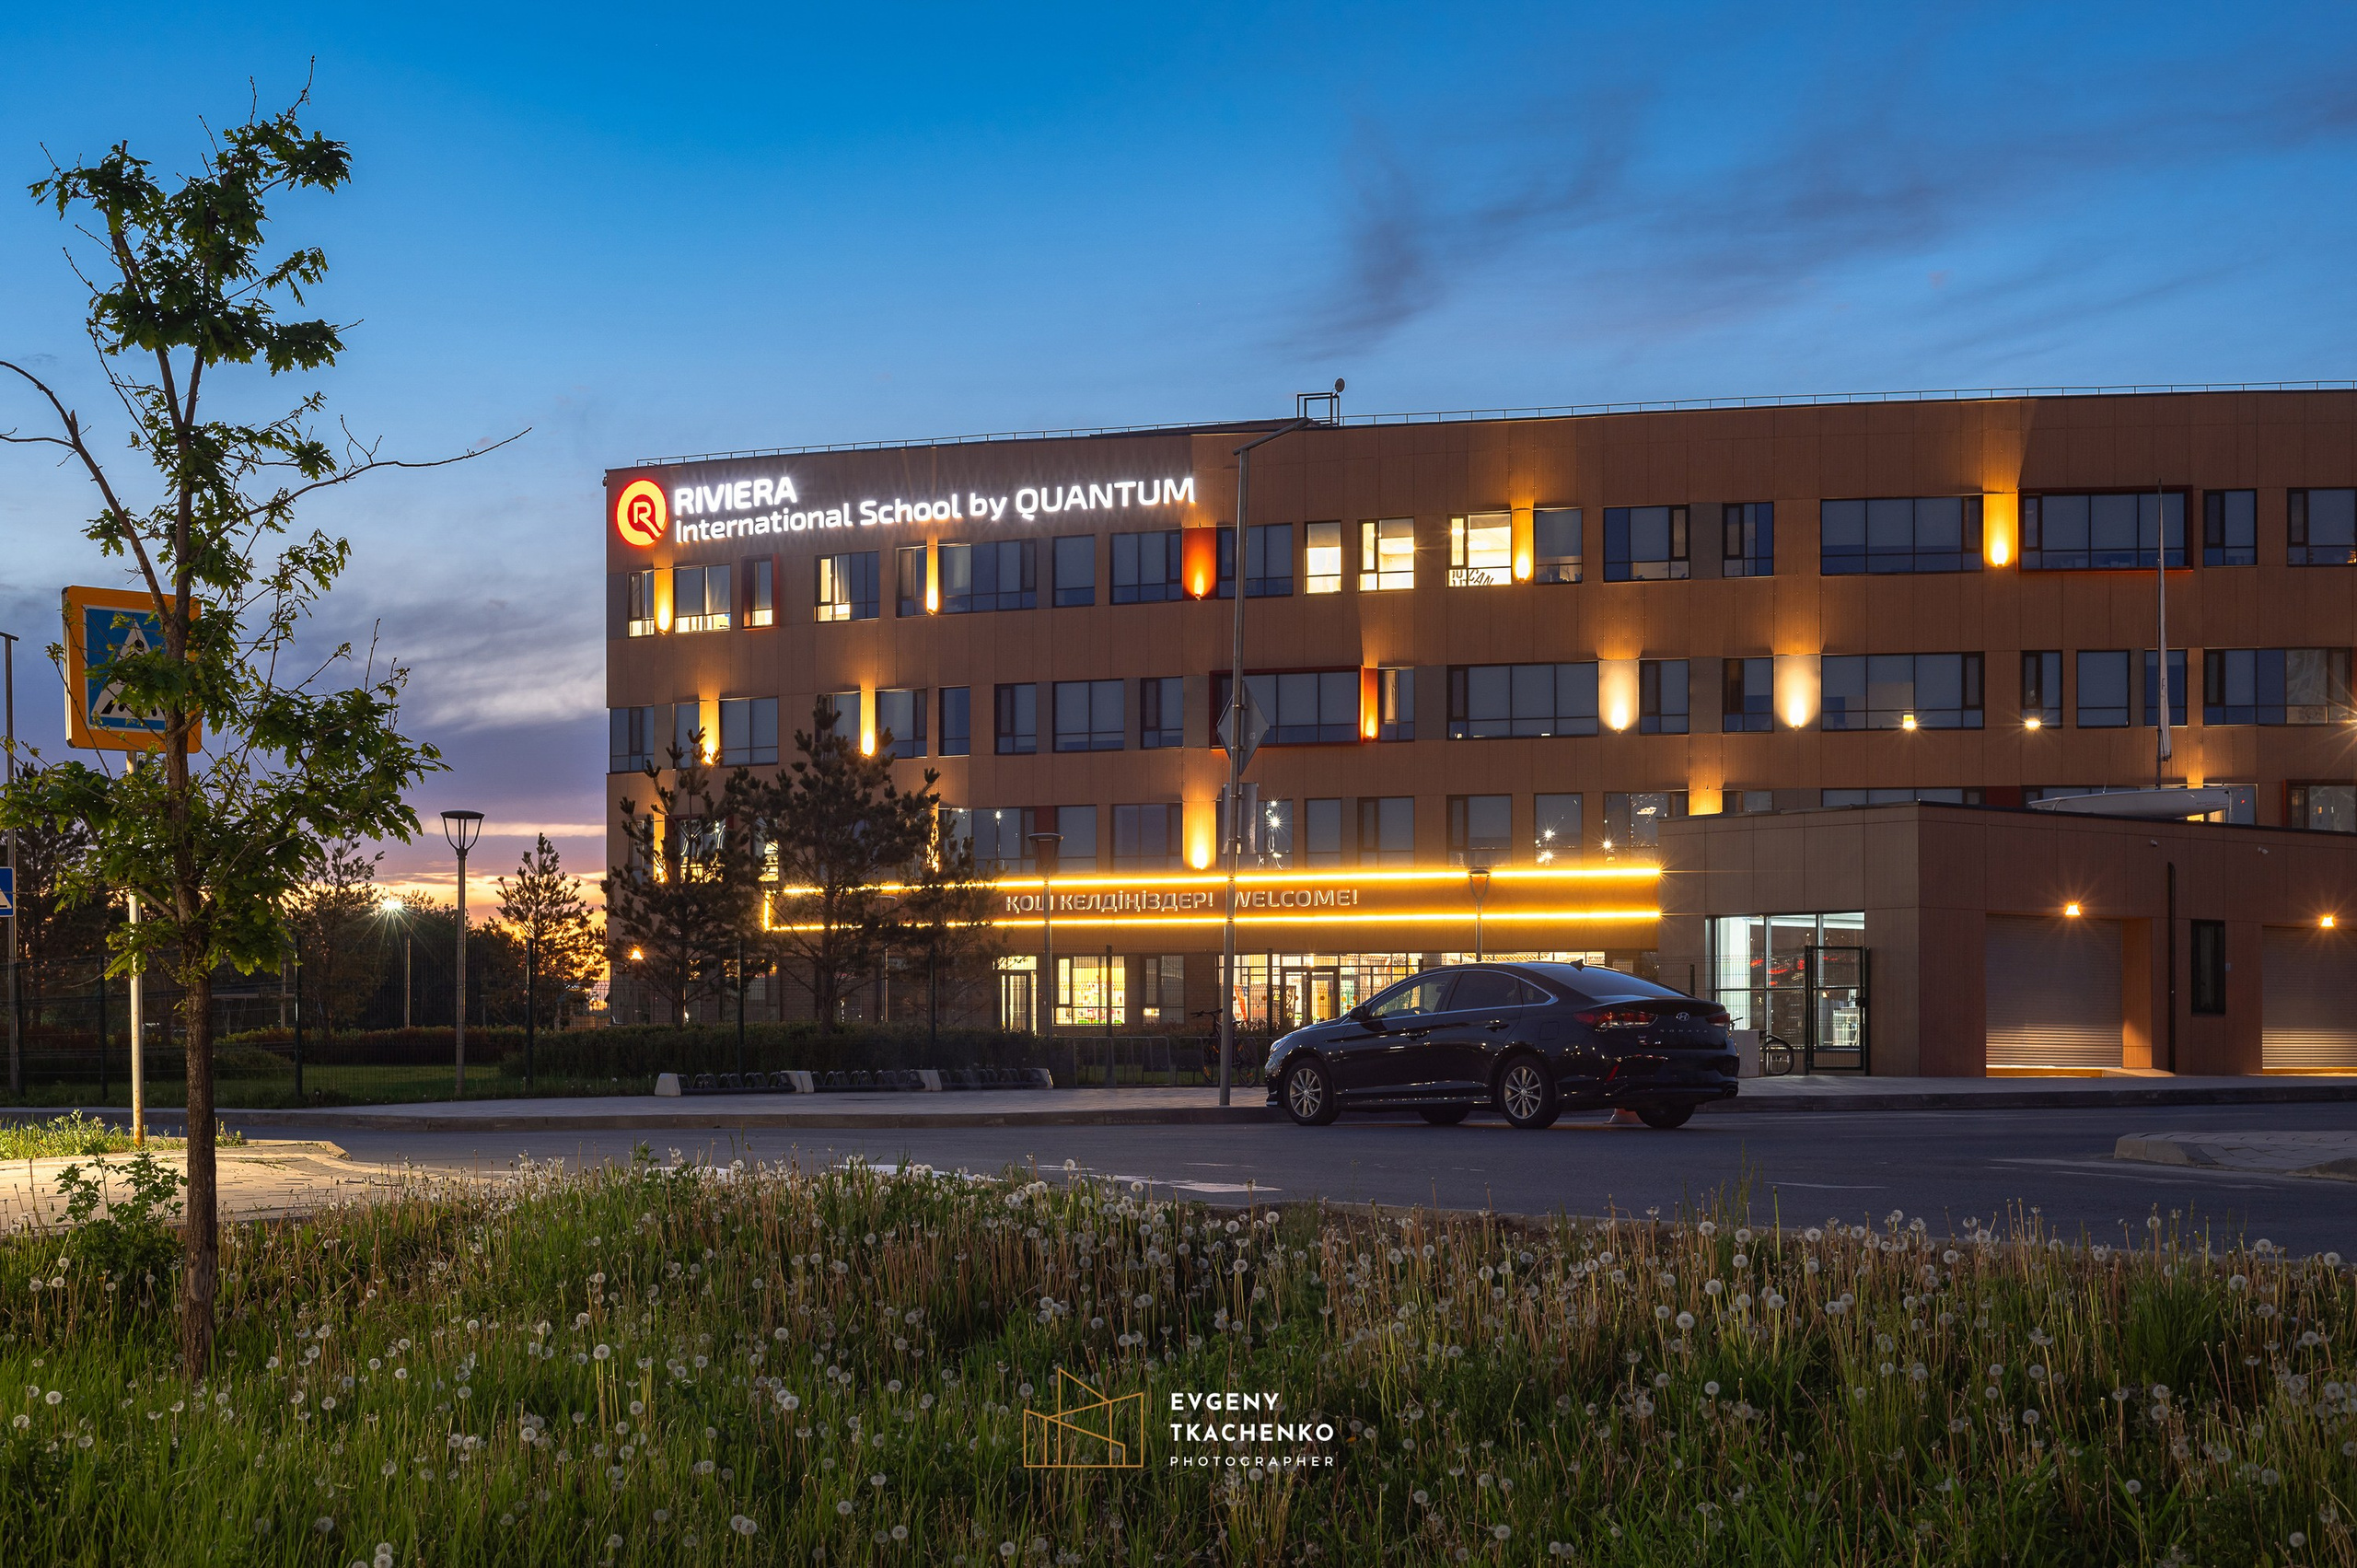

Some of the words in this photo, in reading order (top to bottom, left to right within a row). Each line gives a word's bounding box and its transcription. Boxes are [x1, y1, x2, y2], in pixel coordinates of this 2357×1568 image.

[674, 476, 798, 516] RIVIERA
[675, 503, 854, 543] International
[859, 493, 963, 526] School
[969, 493, 1008, 521] by
[1015, 477, 1196, 521] QUANTUM
[1234, 889, 1358, 908] WELCOME!
